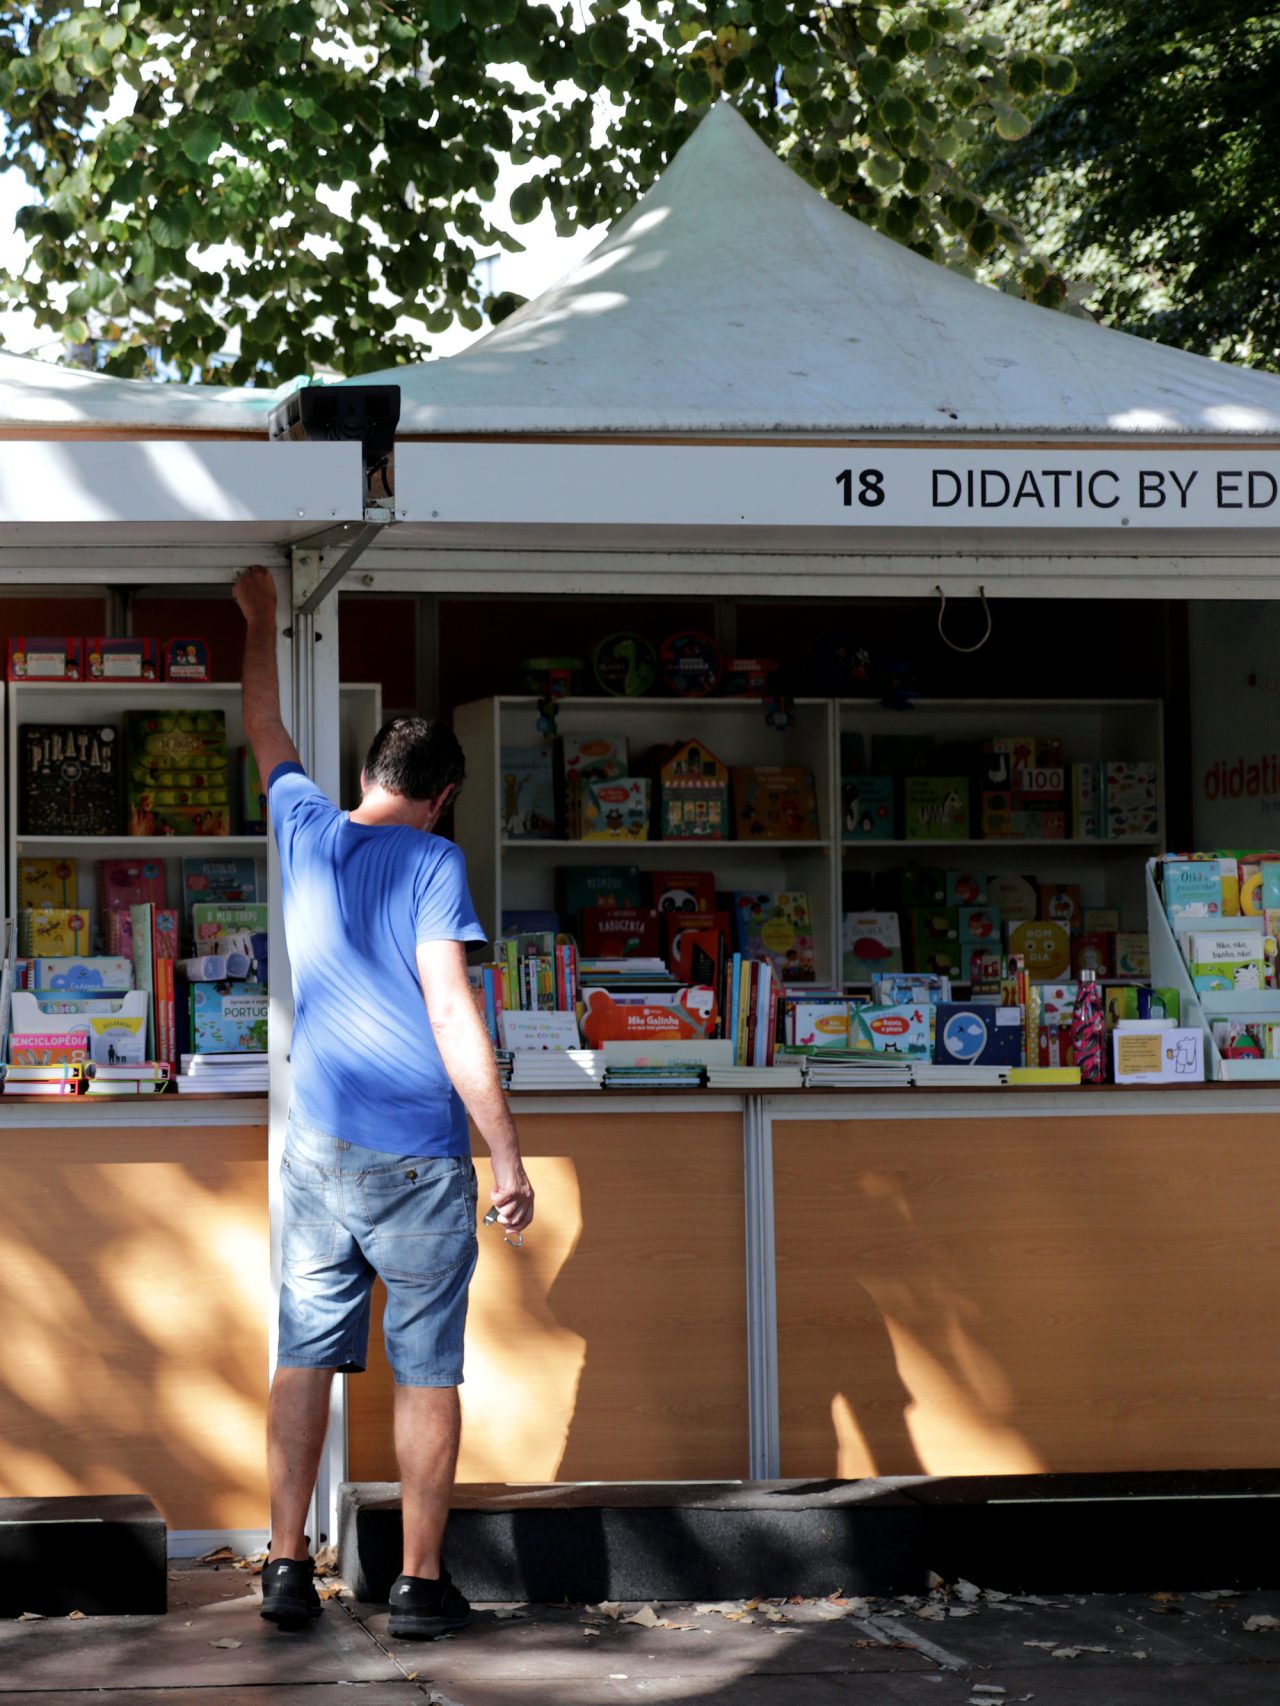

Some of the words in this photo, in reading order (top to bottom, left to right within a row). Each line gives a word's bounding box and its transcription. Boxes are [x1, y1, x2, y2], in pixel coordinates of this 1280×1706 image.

[835, 469, 886, 507] 18
[931, 469, 1120, 508] DIDATIC
[1138, 470, 1199, 508] BY
[1216, 470, 1280, 508] ED
[31, 730, 113, 773] PIRATAS
[1028, 771, 1061, 785] 100
[1204, 754, 1280, 801] didati
[1026, 929, 1053, 938] BOM
[1029, 952, 1050, 962] DIA
[223, 1006, 268, 1018] PORTUG
[627, 1015, 645, 1026] Mãe
[646, 1015, 680, 1026] Galinha
[13, 1034, 88, 1047] ENCICLOPÉDIA
